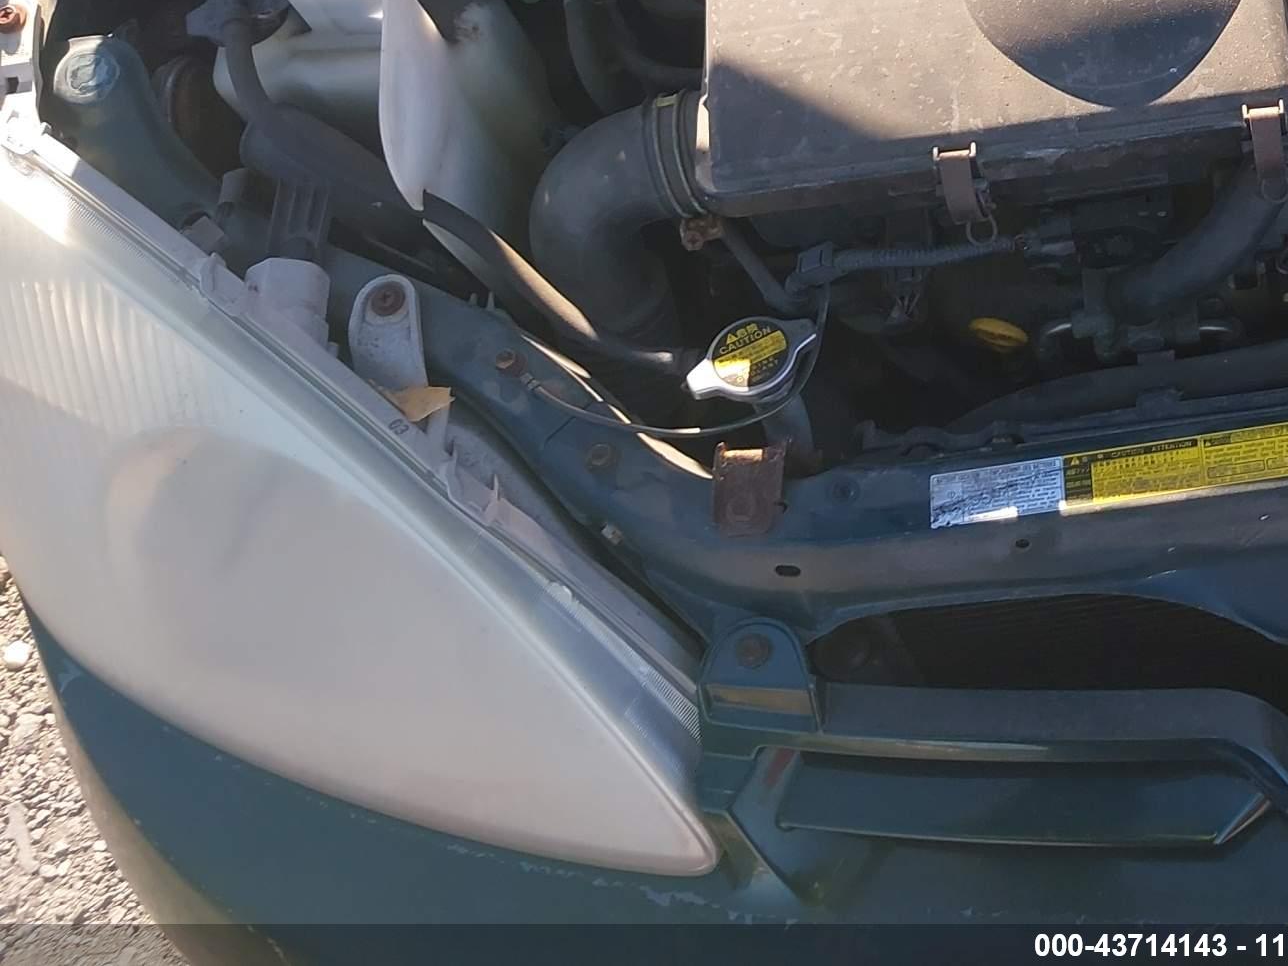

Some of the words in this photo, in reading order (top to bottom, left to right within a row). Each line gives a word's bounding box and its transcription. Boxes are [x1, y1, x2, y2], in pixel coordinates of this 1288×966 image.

[720, 325, 771, 354] CAUTION
[1111, 449, 1145, 459] CAUTION
[1151, 440, 1193, 452] ATTENTION
